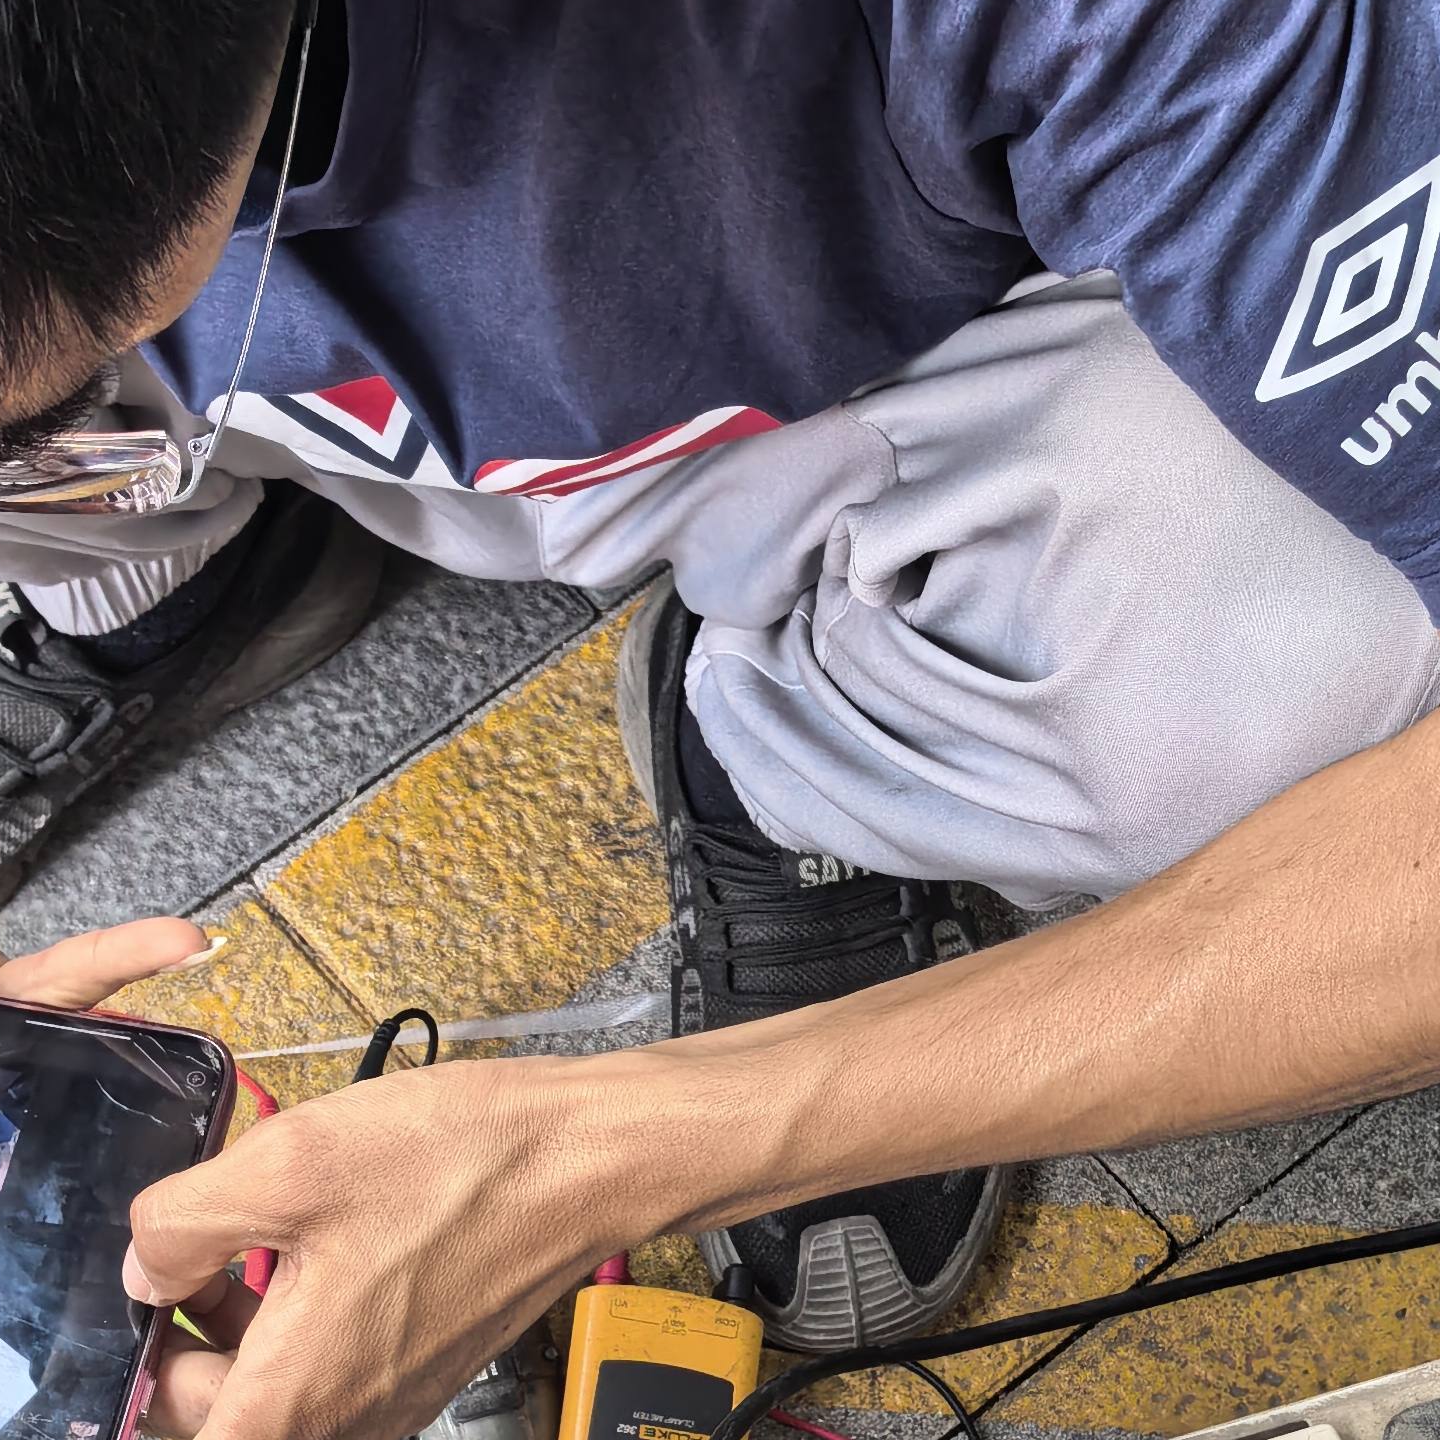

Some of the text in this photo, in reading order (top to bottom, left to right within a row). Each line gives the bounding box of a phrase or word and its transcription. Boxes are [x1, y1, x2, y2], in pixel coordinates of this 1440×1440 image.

[632, 1410, 695, 1428] CLAMP METER
[615, 1422, 637, 1435] 362
